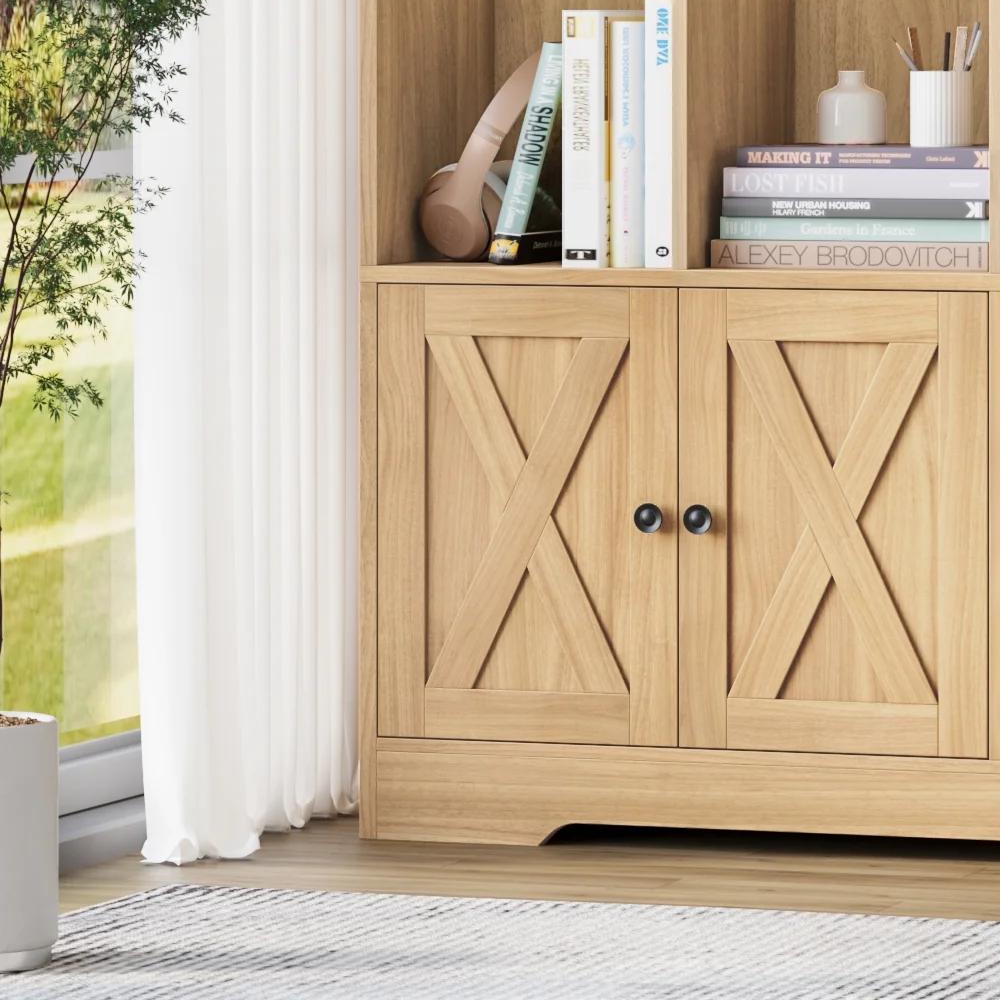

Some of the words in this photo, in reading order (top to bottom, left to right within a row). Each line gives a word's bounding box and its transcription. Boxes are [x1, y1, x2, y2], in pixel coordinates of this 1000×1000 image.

[518, 106, 553, 166] SHADOW
[747, 152, 812, 164] MAKING
[814, 152, 832, 164] IT
[731, 173, 790, 194] LOST
[795, 174, 844, 193] FISH
[772, 200, 792, 210] NEW
[794, 200, 828, 210] URBAN
[828, 200, 870, 210] HOUSING
[800, 222, 852, 236] Gardens
[872, 224, 916, 237] France
[718, 244, 808, 266] ALEXEY
[816, 246, 970, 268] BRODOVITCH
